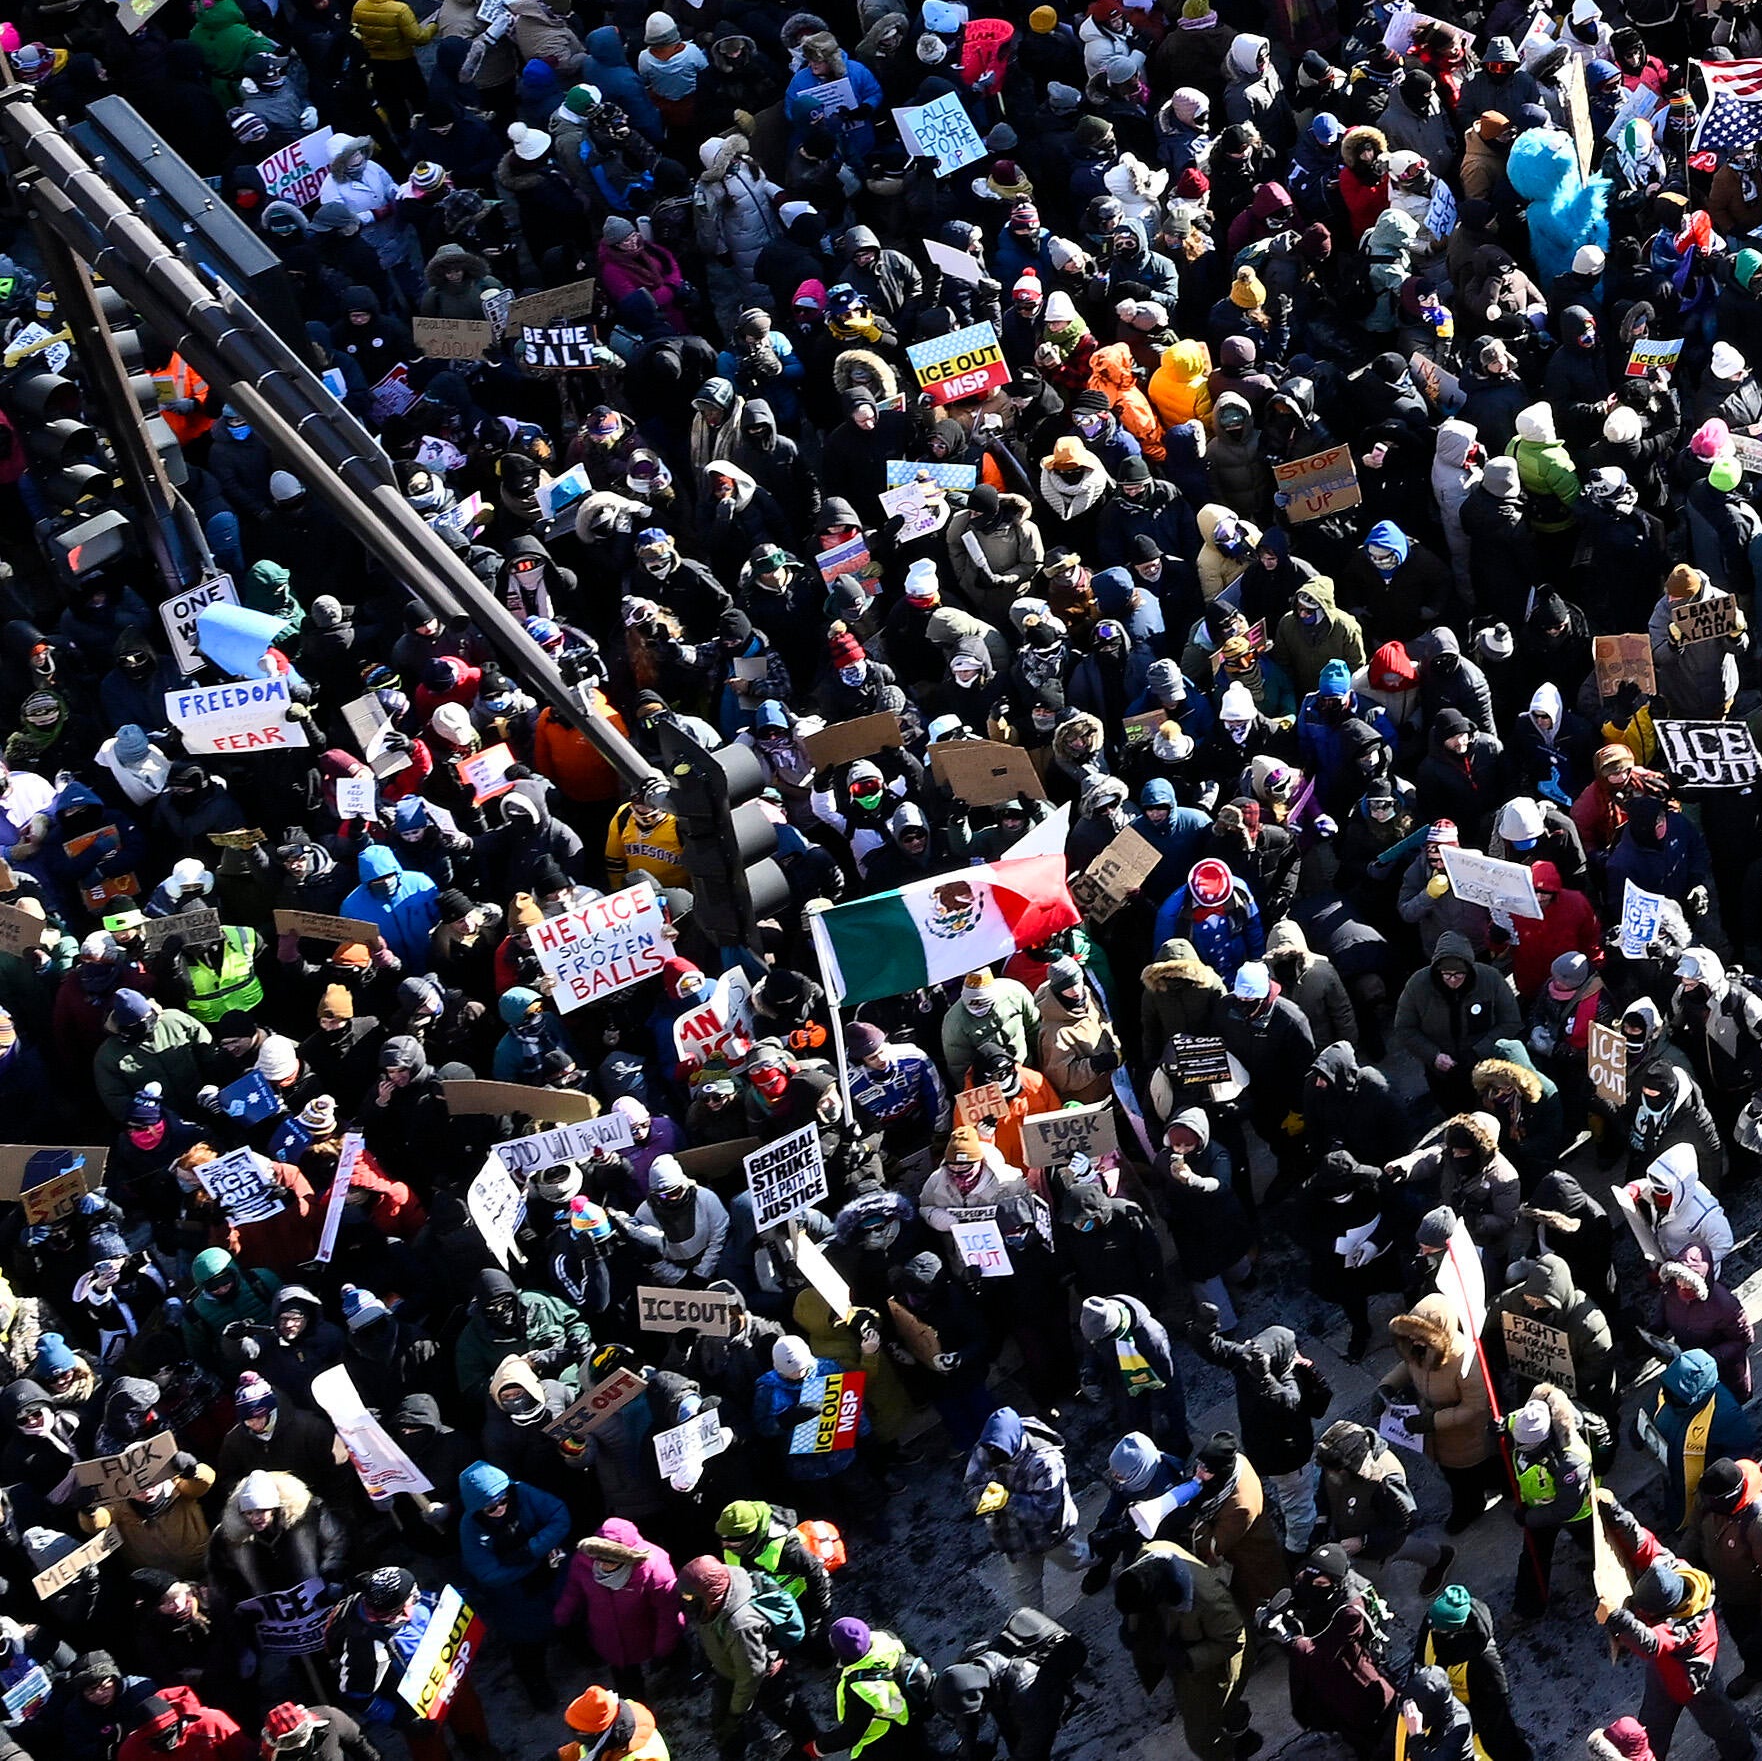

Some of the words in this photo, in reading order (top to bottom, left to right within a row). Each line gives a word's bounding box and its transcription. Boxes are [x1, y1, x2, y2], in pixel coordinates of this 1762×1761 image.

[915, 113, 968, 141] POWER
[523, 327, 548, 343] BE
[553, 326, 588, 344] THE
[526, 344, 594, 365] SALT
[919, 361, 954, 384] ICE
[957, 345, 997, 371] OUT
[943, 370, 989, 398] MSP
[1275, 447, 1341, 480] STOP
[174, 585, 224, 618] ONE
[1675, 596, 1732, 623] LEAVE
[177, 682, 286, 717] FREEDOM
[213, 727, 285, 750] FEAR
[1665, 722, 1752, 759] ICE
[537, 917, 590, 951] HEY
[604, 890, 651, 928] ICE
[557, 934, 653, 982] FROZEN
[571, 947, 664, 1000] BALLS
[1592, 1035, 1627, 1068] ICE
[1592, 1064, 1625, 1095] OUT
[1038, 1117, 1099, 1139] FUCK
[749, 1130, 816, 1174] GENERAL
[751, 1148, 818, 1195] STRIKE:
[754, 1188, 824, 1224] JUSTICE
